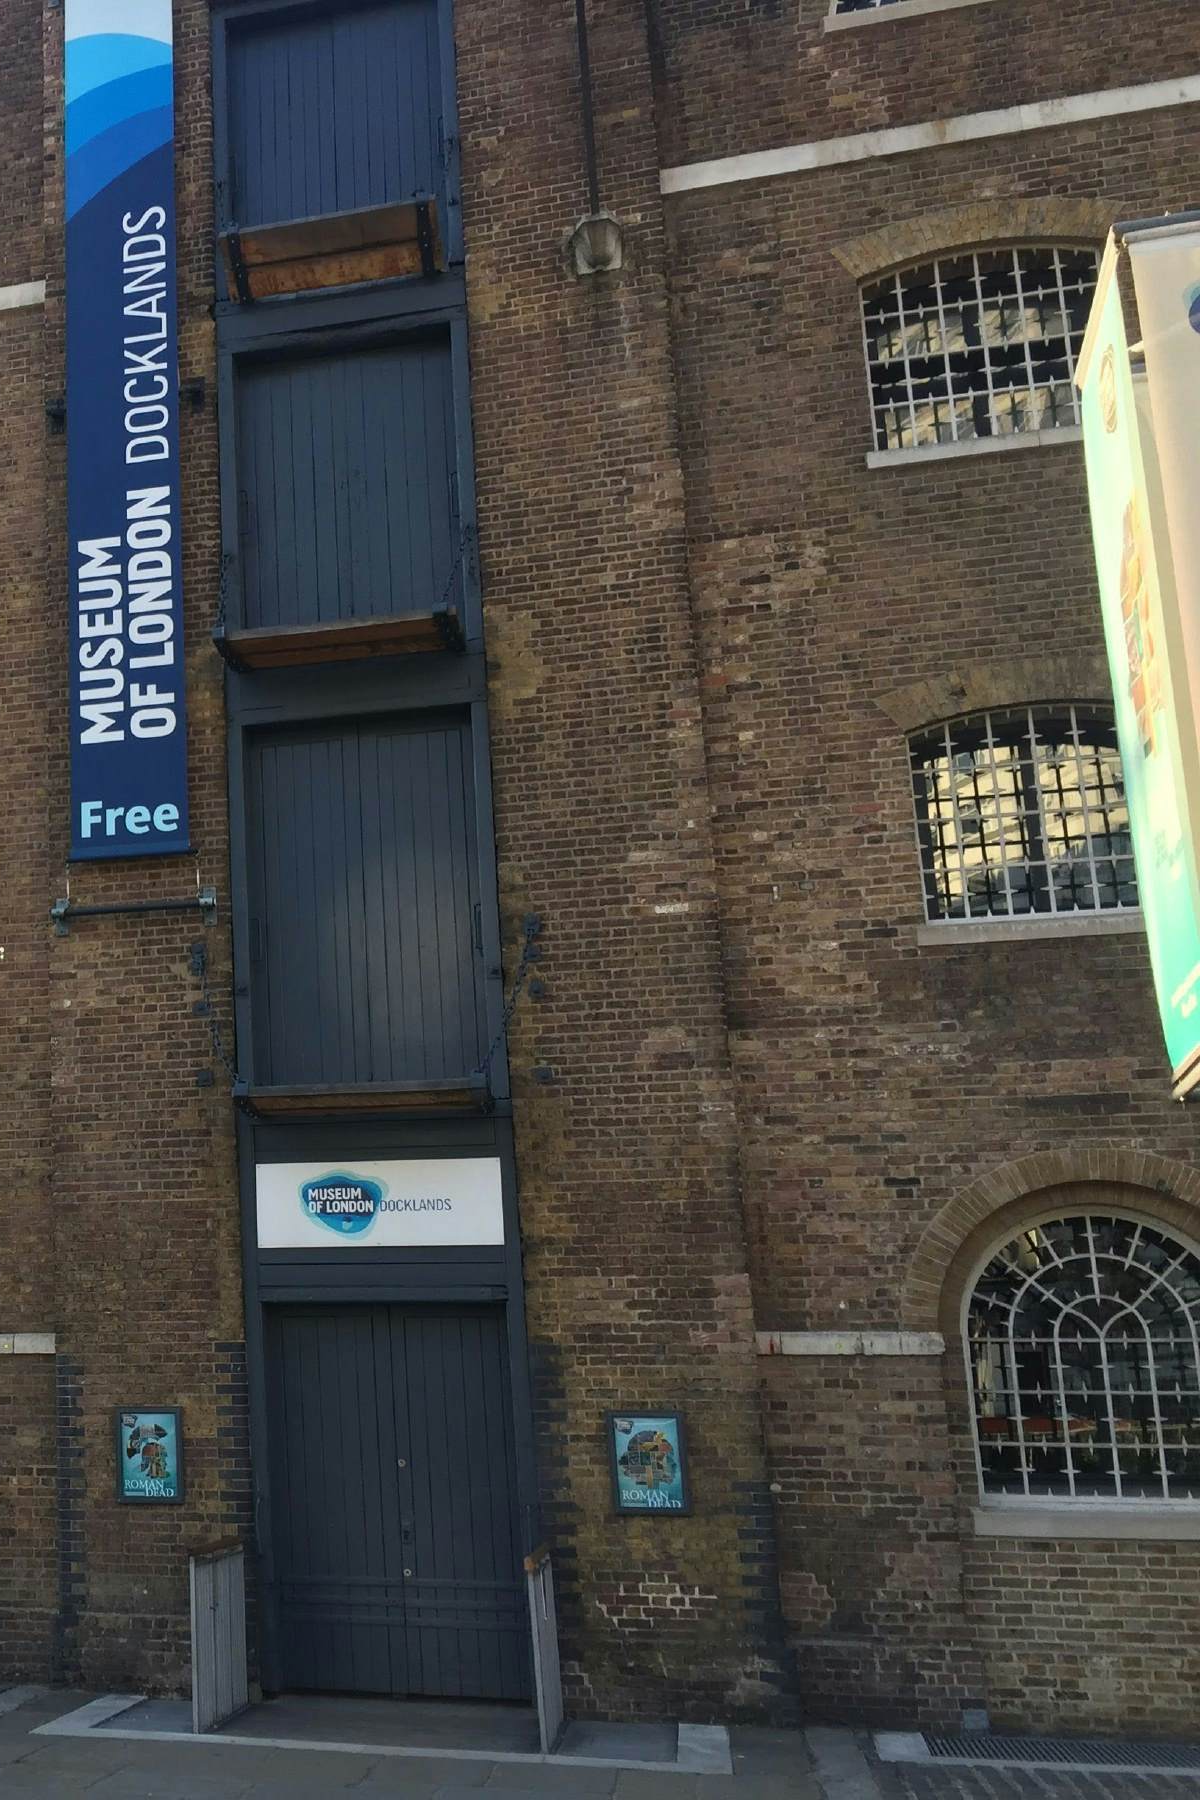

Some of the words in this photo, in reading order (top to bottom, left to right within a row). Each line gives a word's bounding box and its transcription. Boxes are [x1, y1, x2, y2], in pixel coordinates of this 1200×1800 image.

[122, 205, 170, 464] DOCKLANDS
[126, 485, 175, 670] LONDON
[77, 534, 125, 745] MUSEUM
[129, 682, 177, 741] OF
[80, 800, 180, 839] Free
[308, 1187, 362, 1200] MUSEUM
[308, 1201, 324, 1213] OF
[326, 1200, 374, 1213] LONDON
[380, 1198, 452, 1212] DOCKLANDS
[125, 1480, 165, 1490] ROMAN
[145, 1487, 175, 1497] DEAD
[622, 1490, 669, 1501] ROMAN
